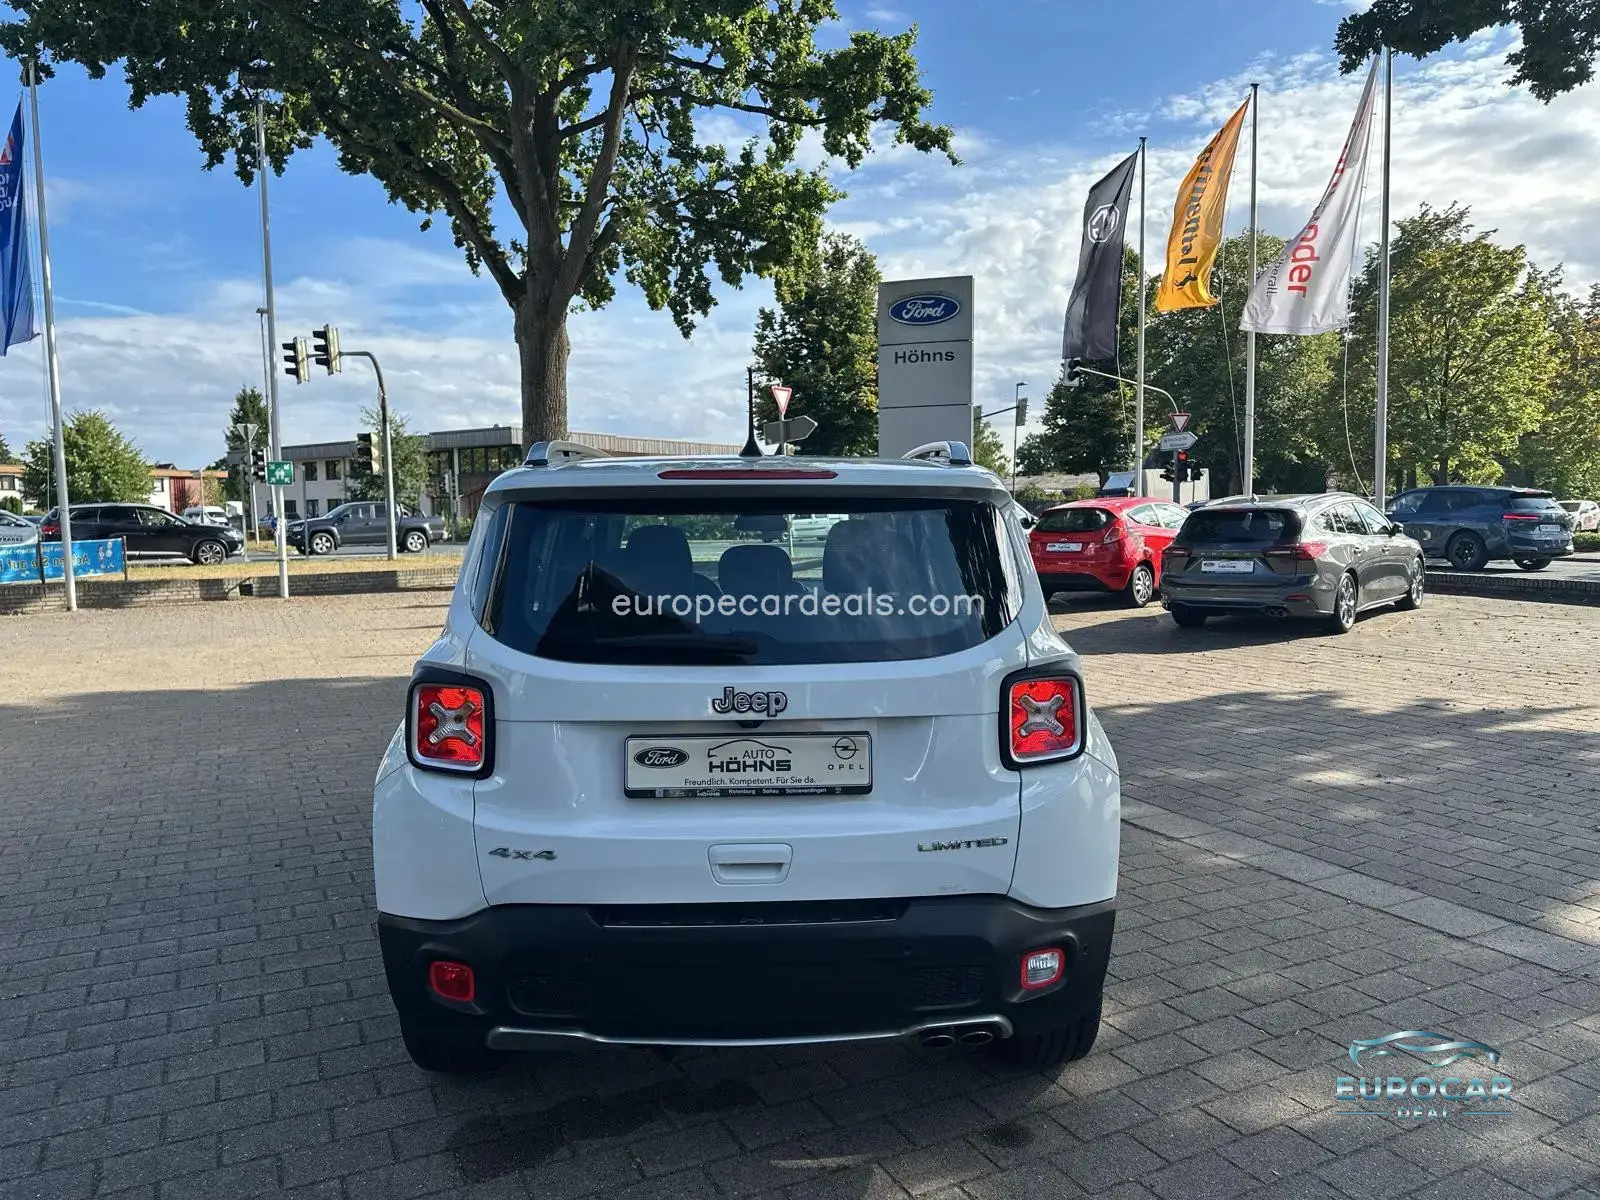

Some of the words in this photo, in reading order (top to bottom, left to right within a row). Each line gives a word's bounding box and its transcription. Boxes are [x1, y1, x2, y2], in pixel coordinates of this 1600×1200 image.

[901, 299, 945, 319] Ford
[894, 350, 955, 364] Höhns
[712, 687, 788, 716] Jeep
[644, 750, 678, 765] Ford
[743, 749, 775, 759] AUTO
[709, 757, 792, 773] HÖHNS
[684, 777, 727, 786] Freundlich.
[729, 777, 774, 787] Kompetent.
[776, 776, 789, 784] Für
[790, 776, 802, 784] Sie
[804, 776, 816, 784] da.
[918, 837, 1008, 852] LIMITED
